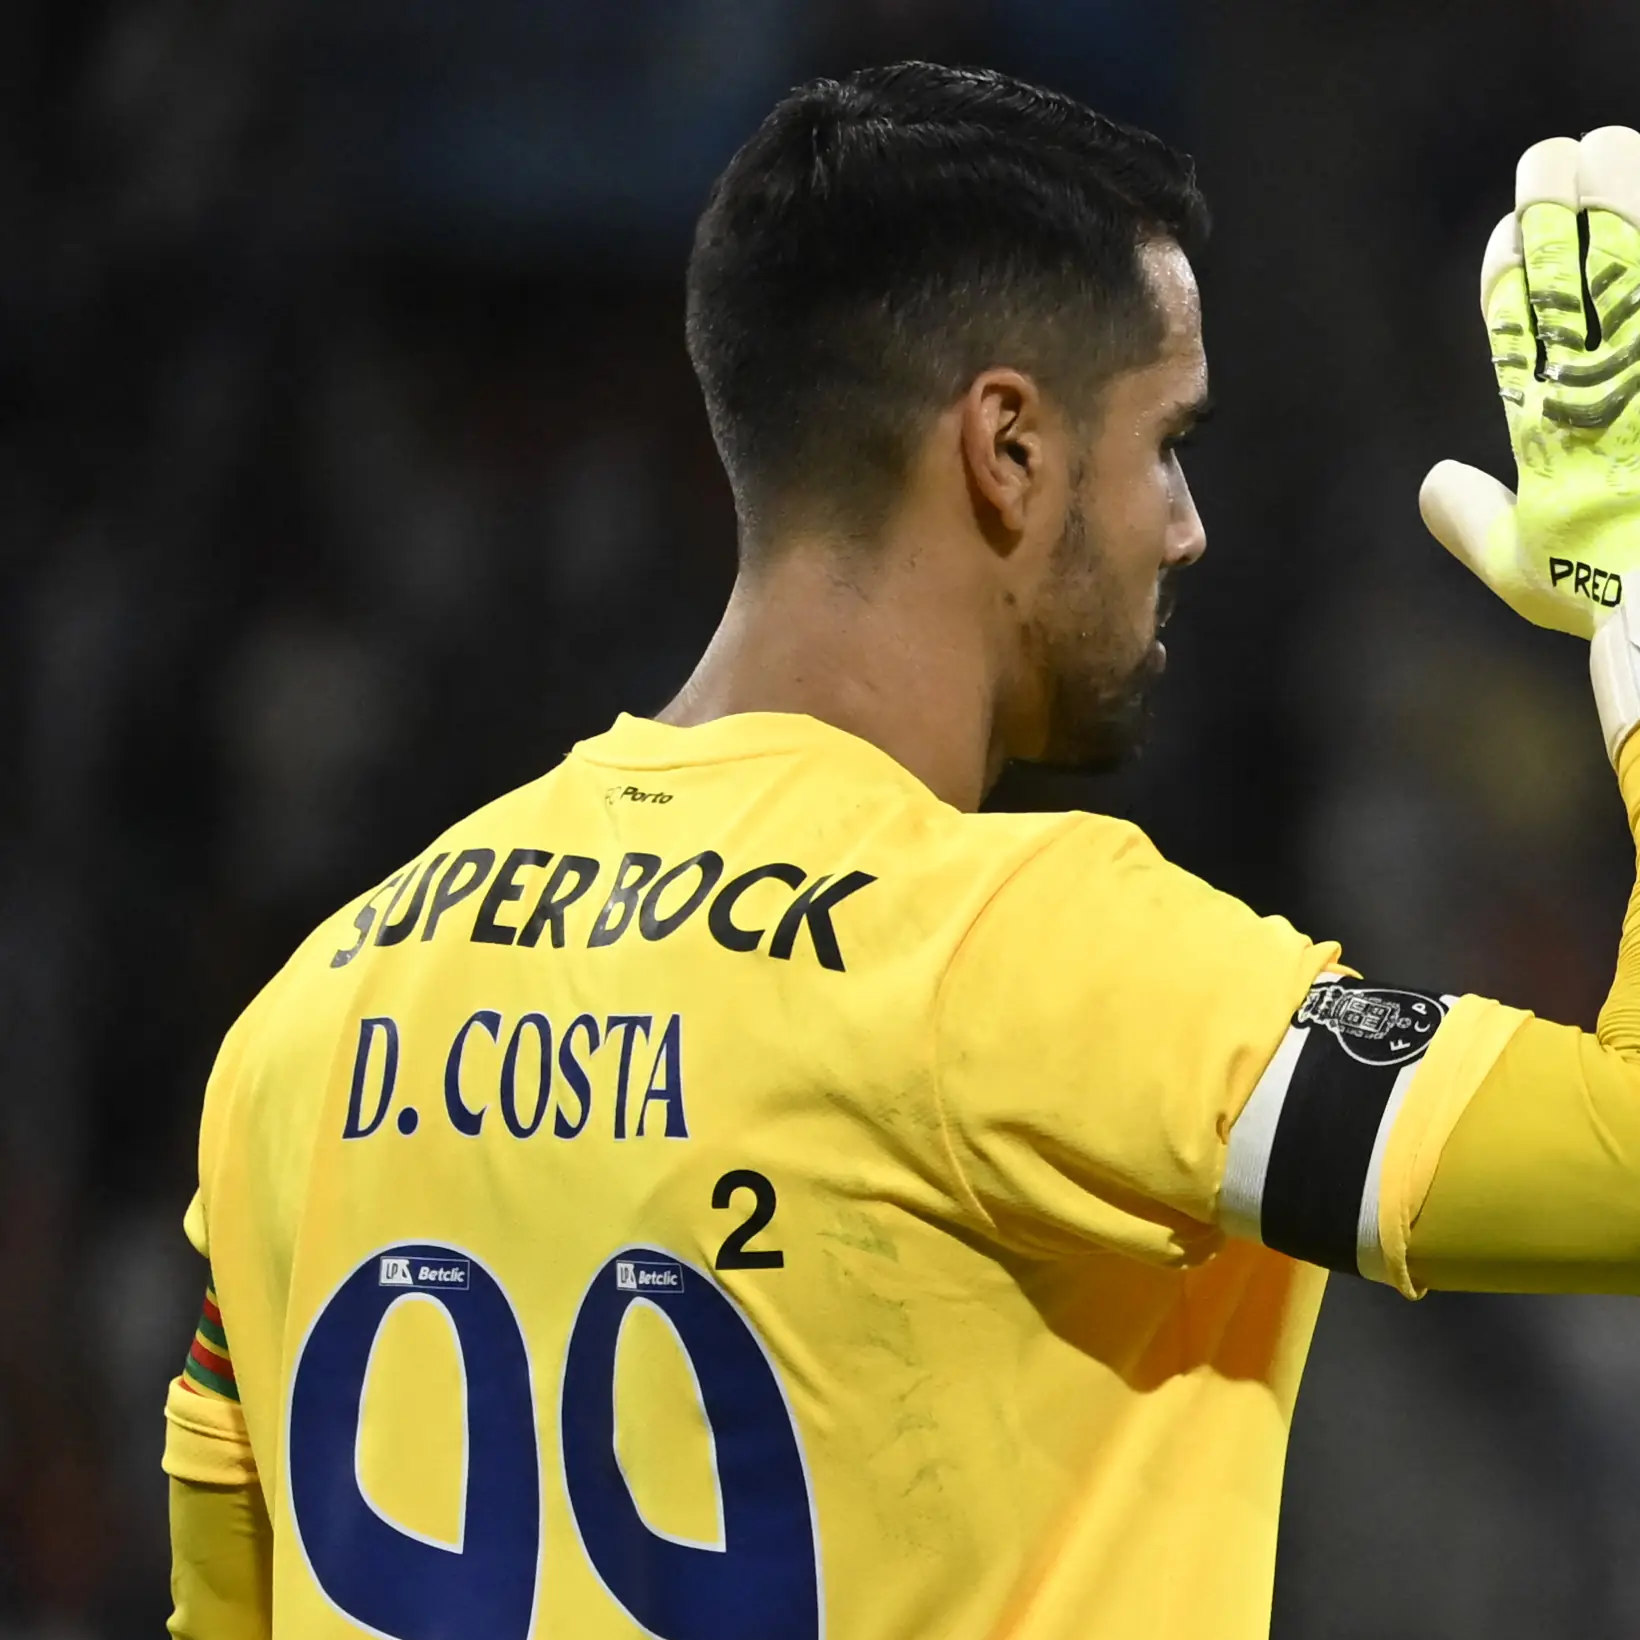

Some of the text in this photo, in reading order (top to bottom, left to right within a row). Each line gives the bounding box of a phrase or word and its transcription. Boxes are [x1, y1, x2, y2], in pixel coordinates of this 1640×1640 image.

[620, 785, 674, 804] Porto
[330, 848, 878, 973] SUPER BOCK
[342, 1008, 690, 1141] D. COSTA
[711, 1169, 784, 1271] 2
[418, 1266, 465, 1282] Betclic
[638, 1270, 678, 1285] Betclic
